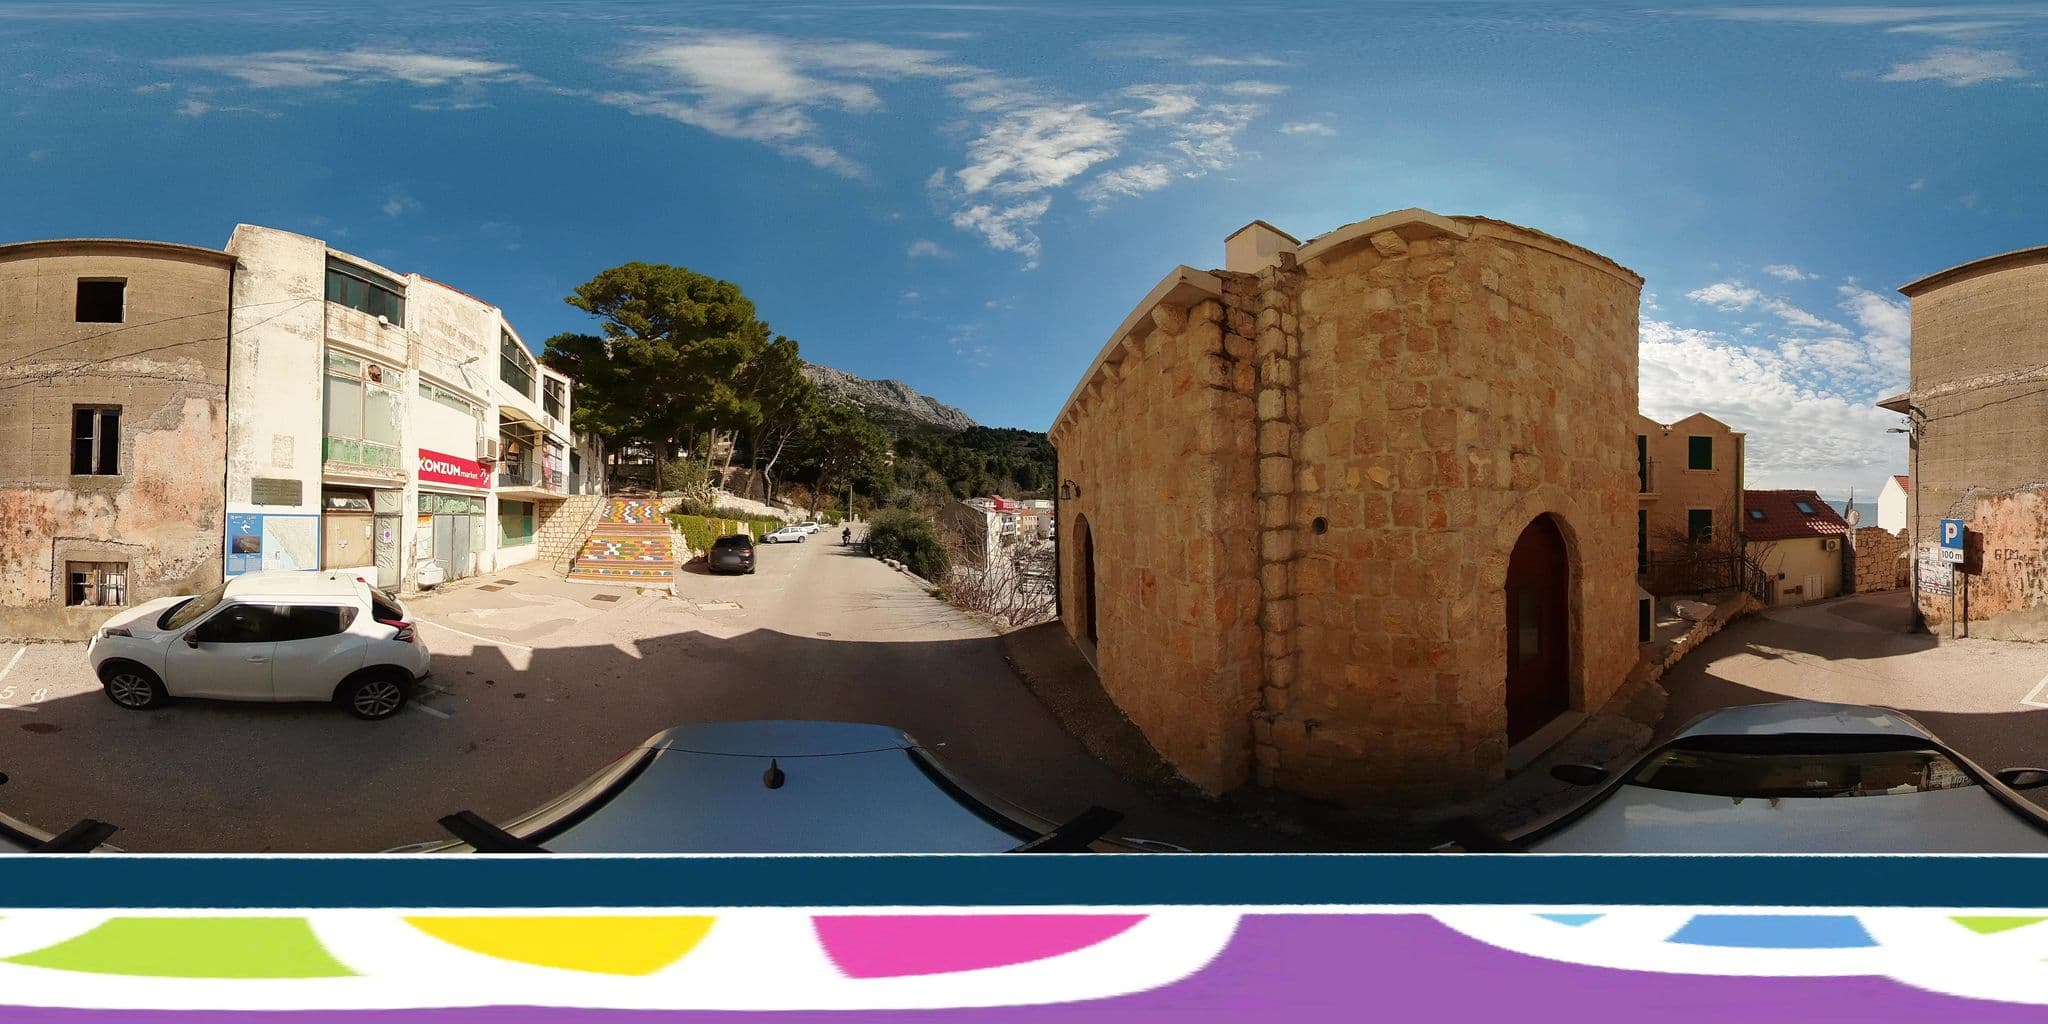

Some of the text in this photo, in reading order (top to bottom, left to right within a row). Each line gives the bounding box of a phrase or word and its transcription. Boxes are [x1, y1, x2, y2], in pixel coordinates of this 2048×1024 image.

[417, 457, 478, 480] KONZUM market
[1945, 522, 1958, 544] P
[1942, 550, 1963, 560] 100 m
